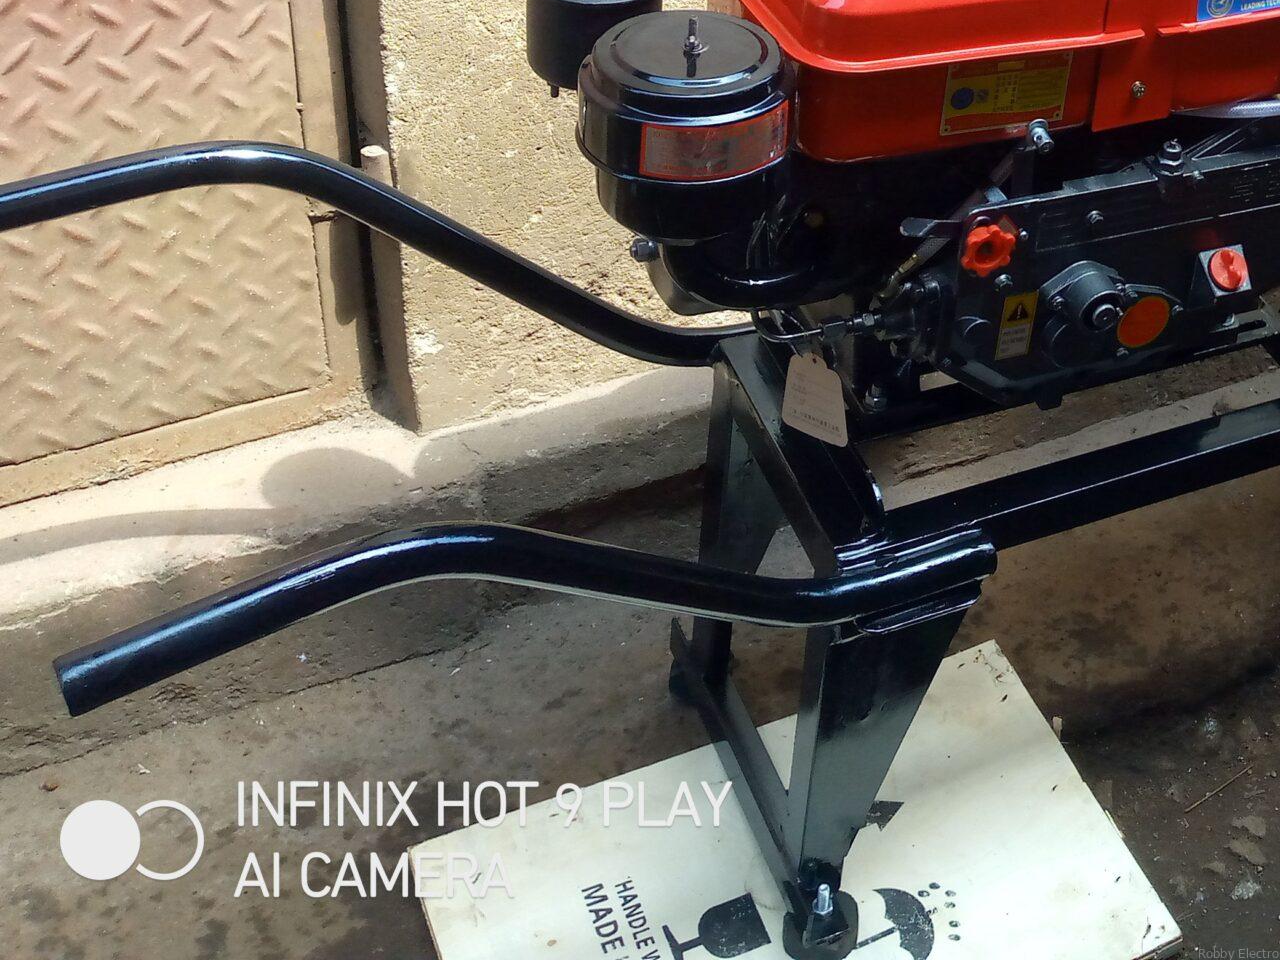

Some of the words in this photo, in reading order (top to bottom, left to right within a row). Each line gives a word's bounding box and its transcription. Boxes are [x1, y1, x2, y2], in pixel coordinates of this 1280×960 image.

[1241, 0, 1266, 11] LEADING
[582, 883, 625, 954] MADE
[615, 879, 655, 950] HANDLE
